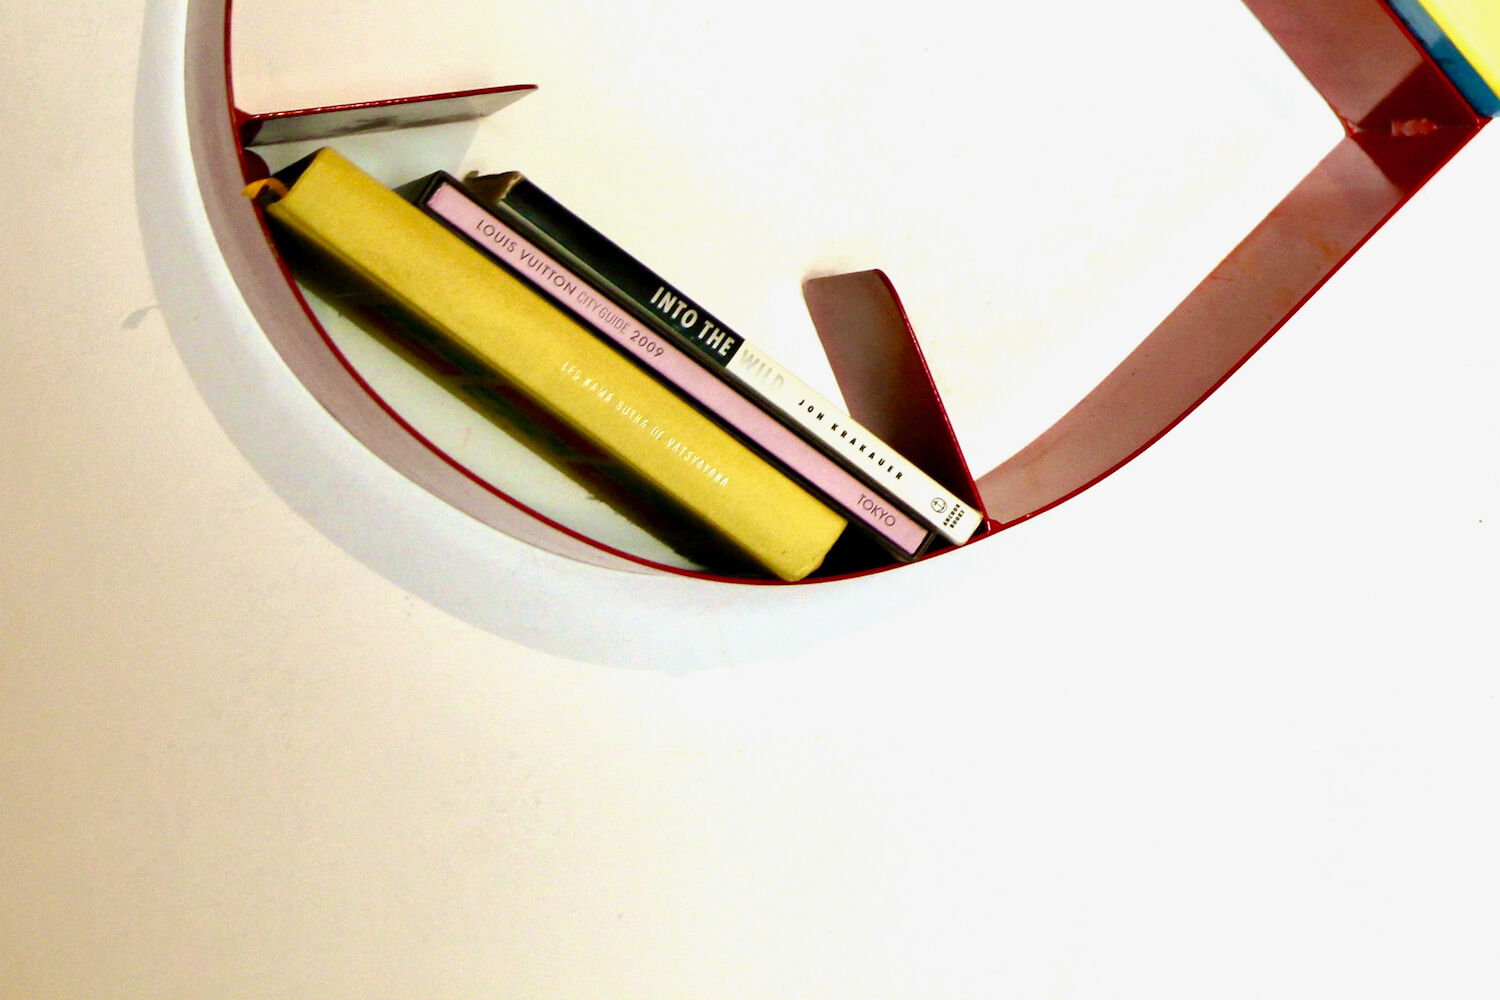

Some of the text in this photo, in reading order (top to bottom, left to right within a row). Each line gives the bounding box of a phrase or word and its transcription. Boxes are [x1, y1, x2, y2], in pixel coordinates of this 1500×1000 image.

[476, 220, 517, 252] LOUIS
[520, 249, 576, 295] VUITTON
[630, 331, 664, 356] 2009
[650, 287, 784, 385] INTO THE WILD
[562, 361, 581, 380] LES
[583, 379, 614, 402] KAMA
[799, 400, 902, 479] JON KRAKAUER
[858, 494, 895, 526] TOKYO
[944, 504, 960, 526] ANCHOR
[950, 510, 964, 528] BOOKS
